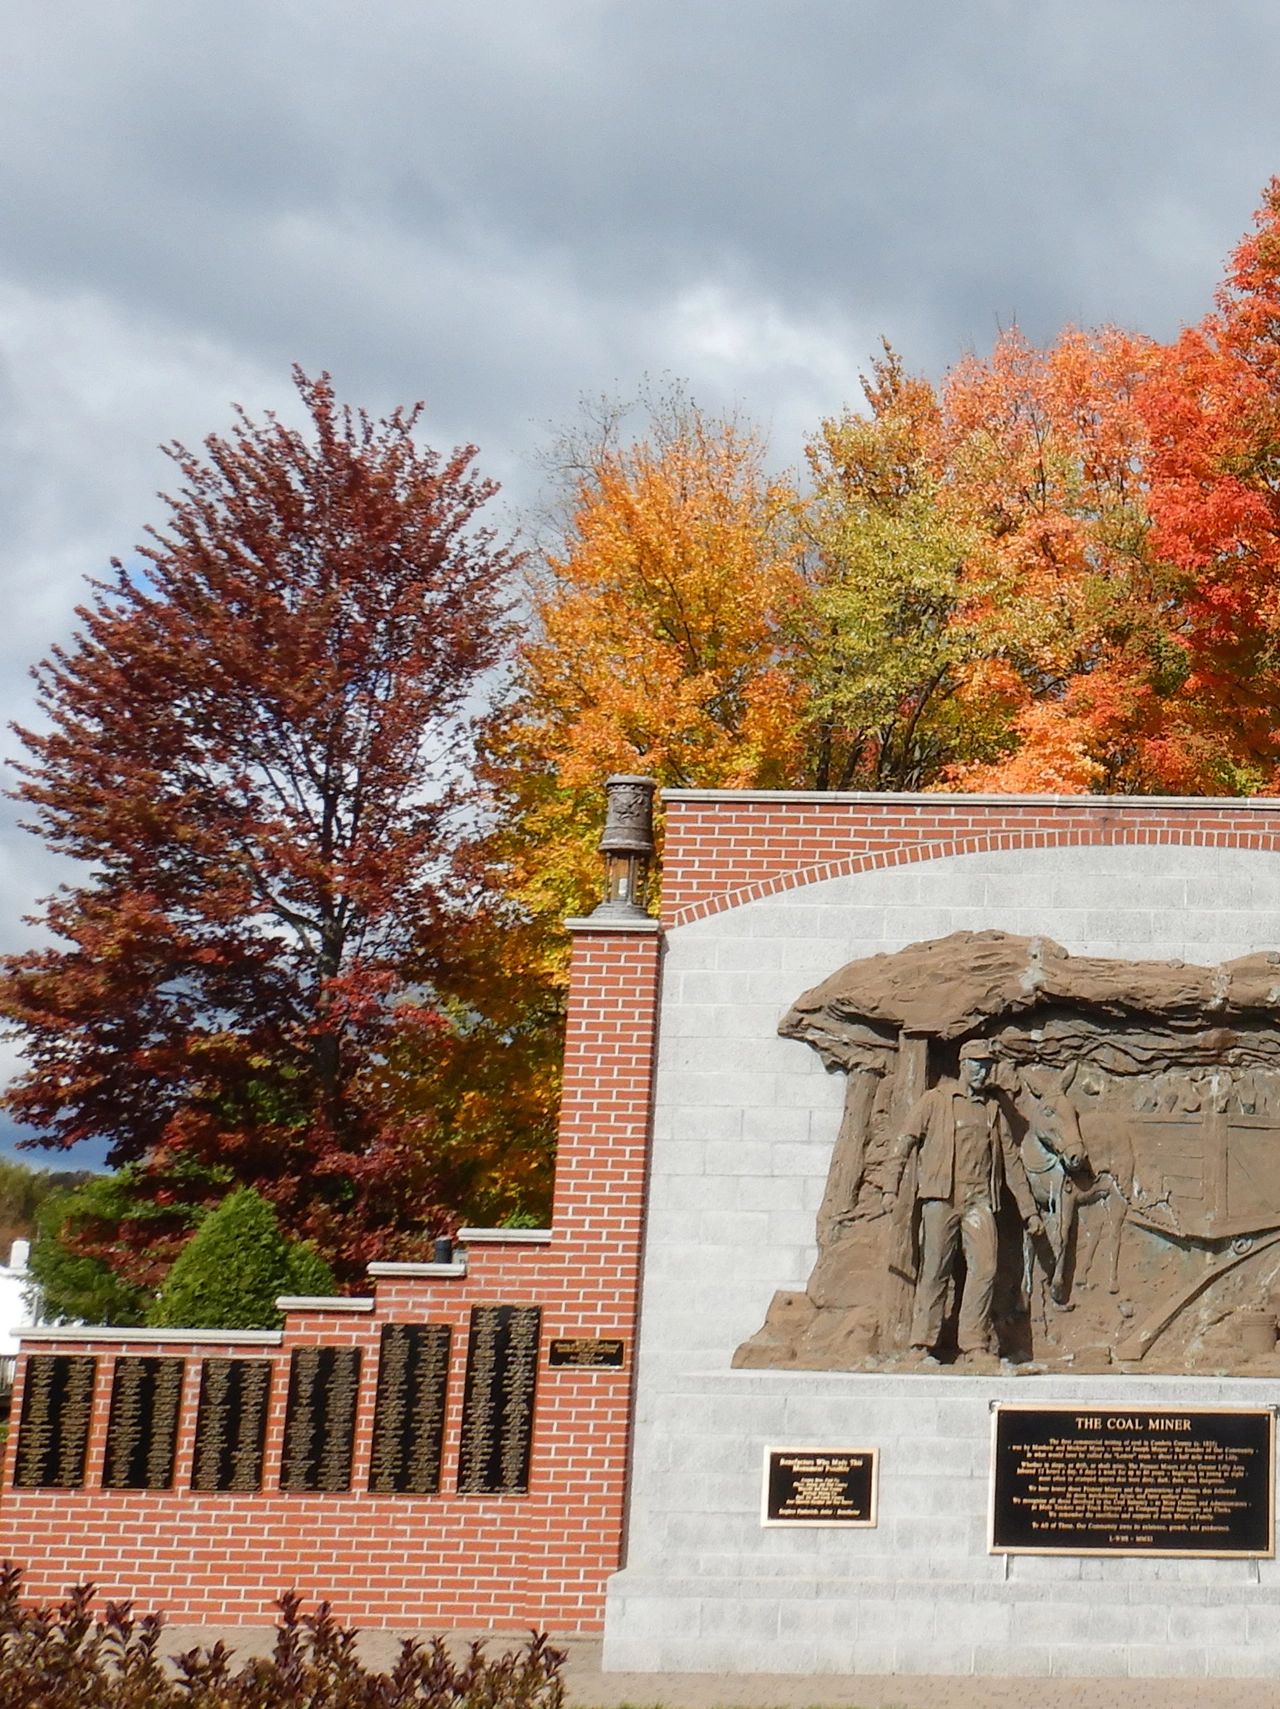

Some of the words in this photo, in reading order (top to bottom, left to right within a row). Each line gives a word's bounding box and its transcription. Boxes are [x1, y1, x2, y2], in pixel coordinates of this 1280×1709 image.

[1076, 1418, 1102, 1430] THE
[1106, 1418, 1143, 1430] COAL
[1148, 1418, 1192, 1431] MINER
